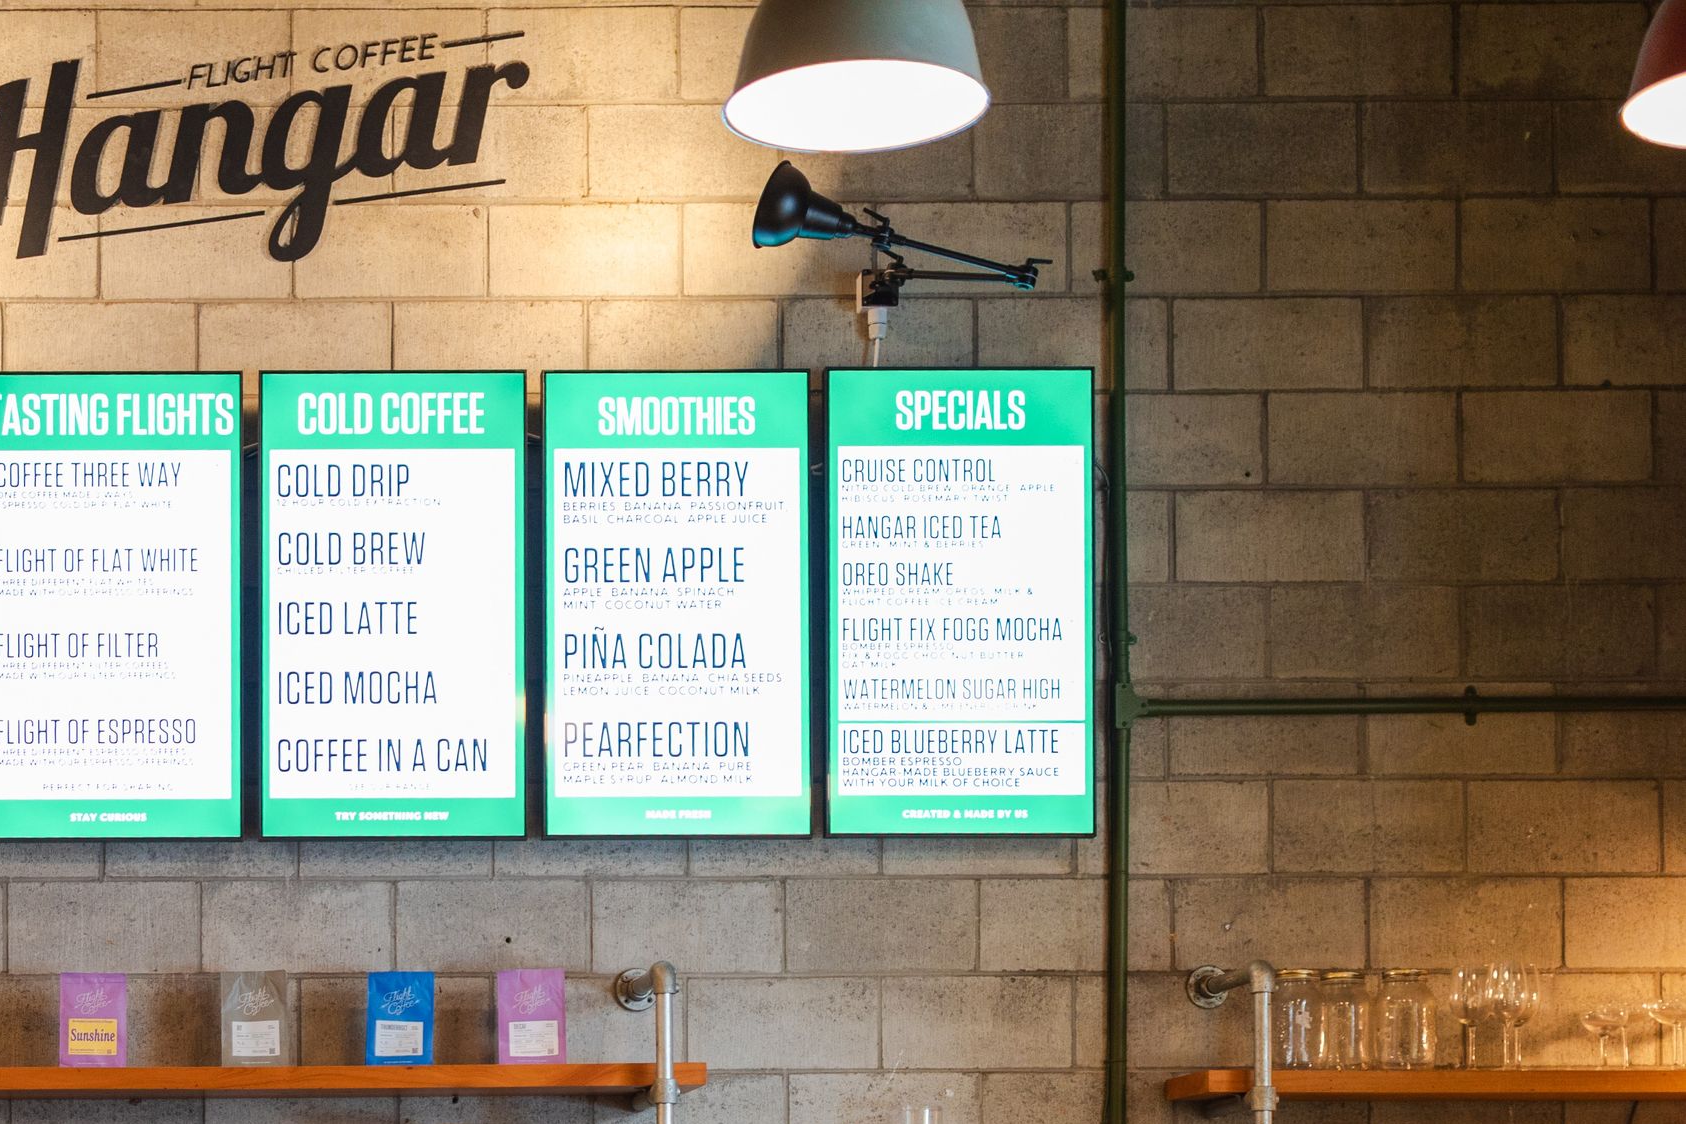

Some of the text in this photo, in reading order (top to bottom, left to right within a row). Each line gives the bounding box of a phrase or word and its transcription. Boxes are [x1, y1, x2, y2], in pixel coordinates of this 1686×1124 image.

[187, 33, 440, 90] FLIGHT COFFEE
[116, 393, 234, 436] FLIGHTS
[297, 392, 485, 435] COLD COFFEE
[598, 396, 756, 436] SMOOTHIES
[896, 390, 1026, 430] SPECIALS
[72, 462, 129, 487] THREE
[139, 462, 181, 487] WAY
[278, 464, 409, 497] COLD DRIP
[564, 462, 748, 497] MIXED BERRY
[842, 459, 995, 482] CRUISE CONTROL
[564, 502, 615, 511] BERRIES
[625, 502, 681, 511] BANANA
[564, 514, 767, 524] BASIL CHARCOAL APPLE JUICE
[842, 516, 1001, 539] HANGAR ICED TEA
[65, 548, 84, 572] OF
[92, 548, 133, 572] FLAT
[141, 548, 198, 572] WHITE
[278, 532, 425, 565] COLD BREW
[564, 548, 744, 583] GREEN APPLE
[842, 563, 953, 586] OREO SHAKE
[278, 602, 417, 635] ICED LATTE
[843, 618, 1062, 641] FLIGHT FIX FOGG MOCHA
[68, 633, 88, 658] OF
[97, 633, 158, 658] FILTER
[564, 626, 746, 669] PIÑA COLADA
[278, 671, 436, 704] ICED MOCHA
[844, 679, 1060, 700] WATERMELON SUGAR HIGH
[68, 719, 88, 744] OF
[97, 719, 196, 744] ESPRESSO
[564, 722, 748, 757] PEARFECTION
[843, 730, 1059, 754] ICED BLUEBERRY LATTE
[278, 739, 487, 772] COFFEE IN A CAN
[843, 757, 962, 766] BOMBER ESPRESSO
[843, 778, 1020, 787] WITH YOUR MILK OF CHOICE
[943, 768, 1014, 776] BLUEBERRY
[1019, 767, 1059, 776] SAUCE
[70, 1027, 116, 1042] Sunshine
